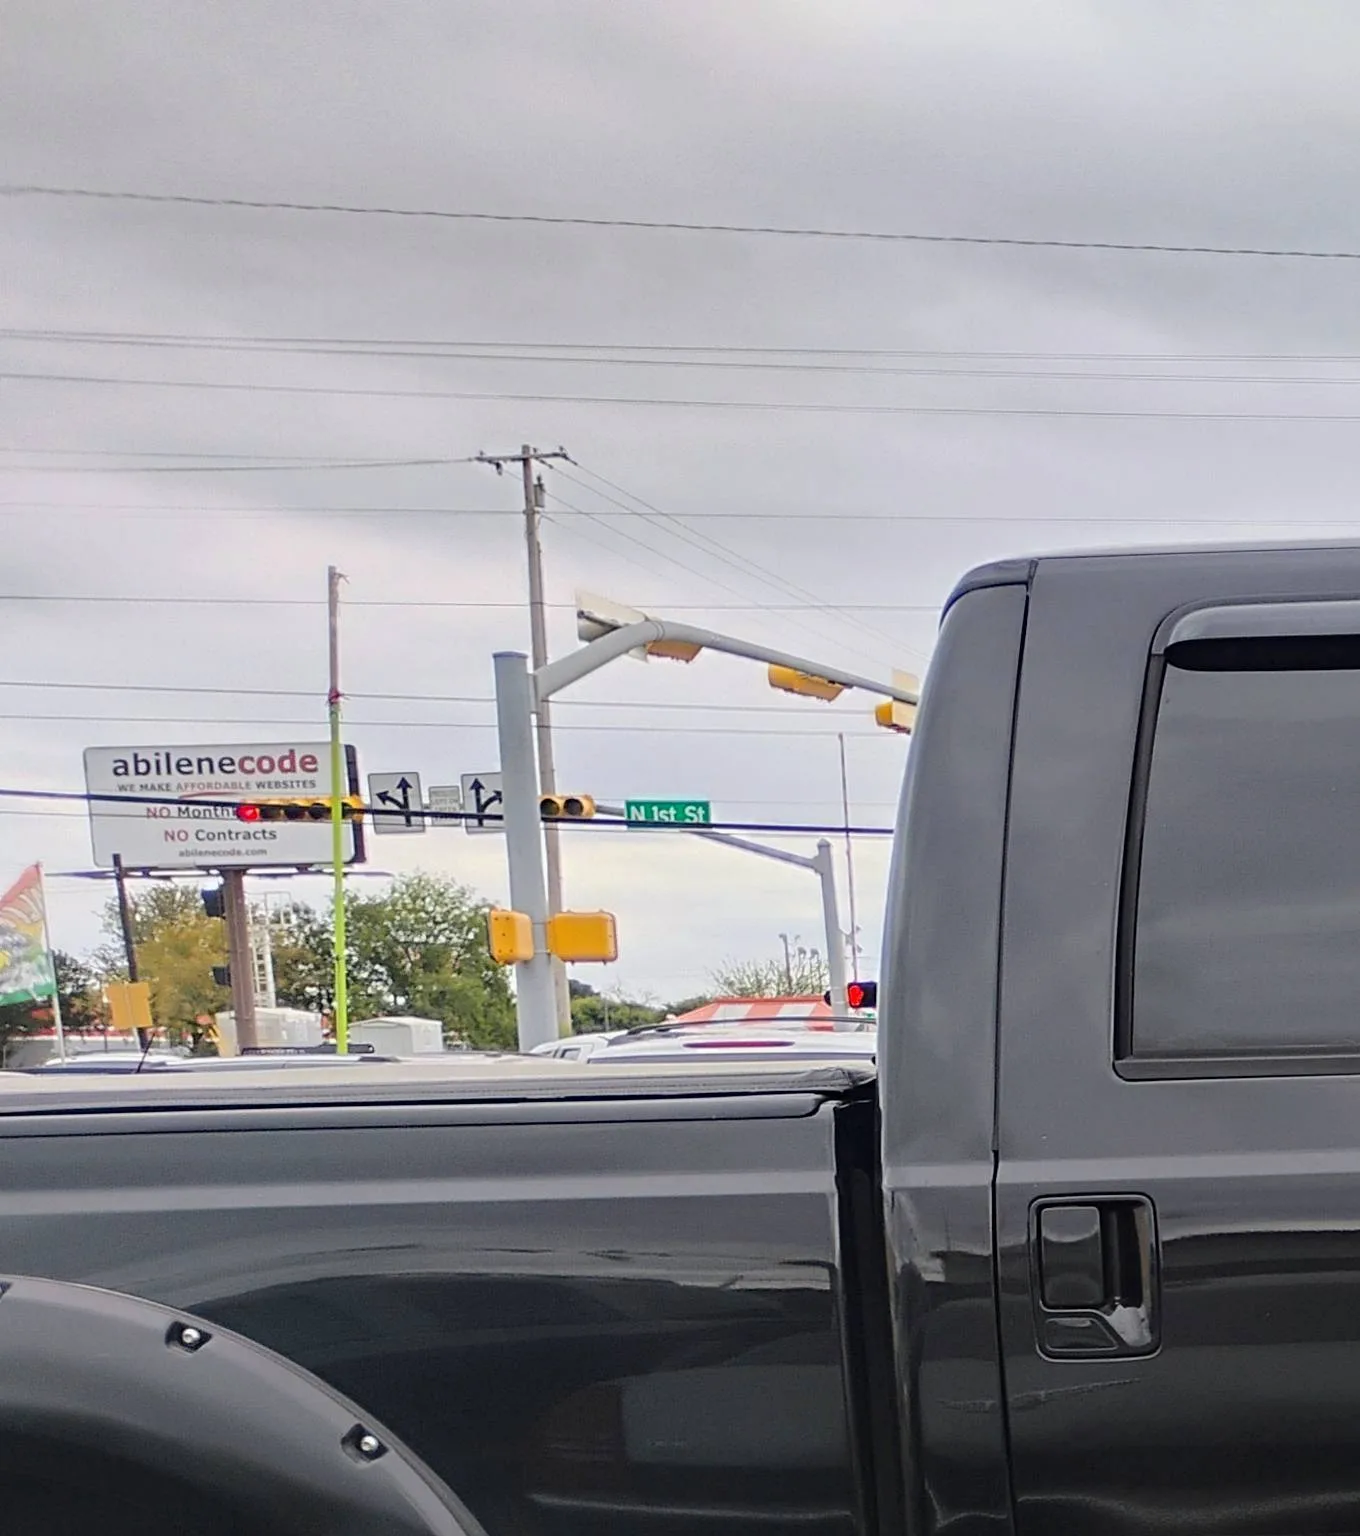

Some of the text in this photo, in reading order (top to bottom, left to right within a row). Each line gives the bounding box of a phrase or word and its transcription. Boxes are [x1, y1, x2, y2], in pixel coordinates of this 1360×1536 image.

[111, 749, 320, 777] abilenecode
[117, 779, 317, 793] WE MAKE AFFORDABLE WEBSITES
[146, 806, 236, 819] NO Month
[630, 805, 706, 823] N 1st St
[164, 827, 278, 843] NO Contracts
[178, 847, 268, 858] abilenecode.com
